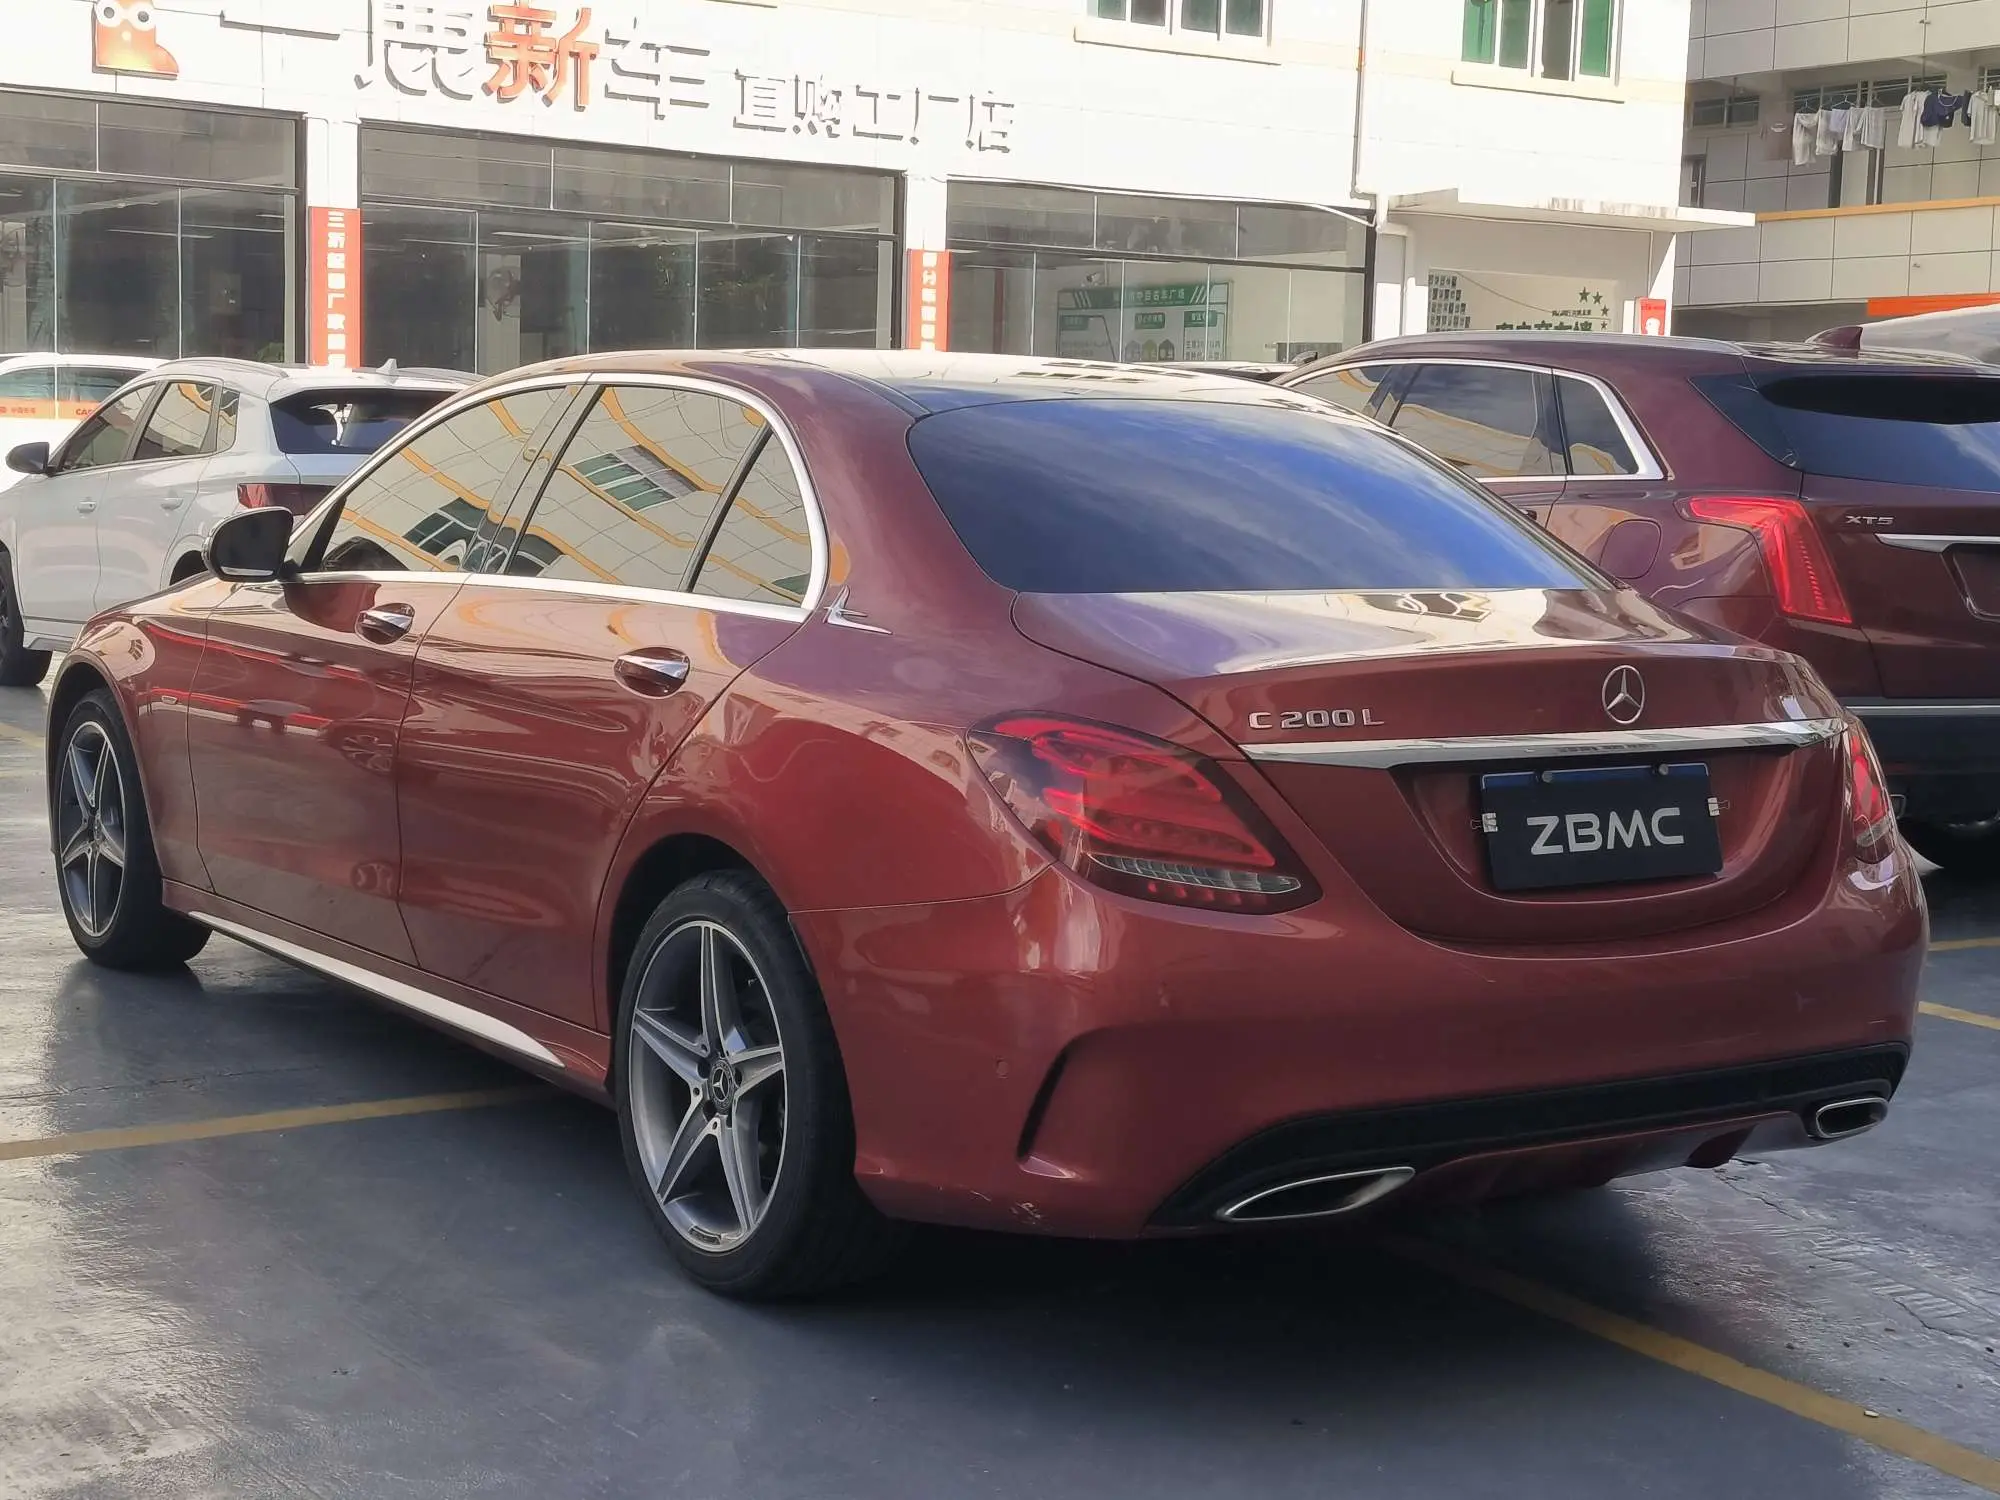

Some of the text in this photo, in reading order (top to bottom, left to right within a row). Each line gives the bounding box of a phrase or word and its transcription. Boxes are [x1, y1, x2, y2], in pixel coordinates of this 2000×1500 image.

[732, 64, 1018, 154] 直购工厂店
[1845, 514, 1895, 526] XT5
[1248, 707, 1385, 730] C 200 L
[1526, 806, 1685, 856] ZBMC
